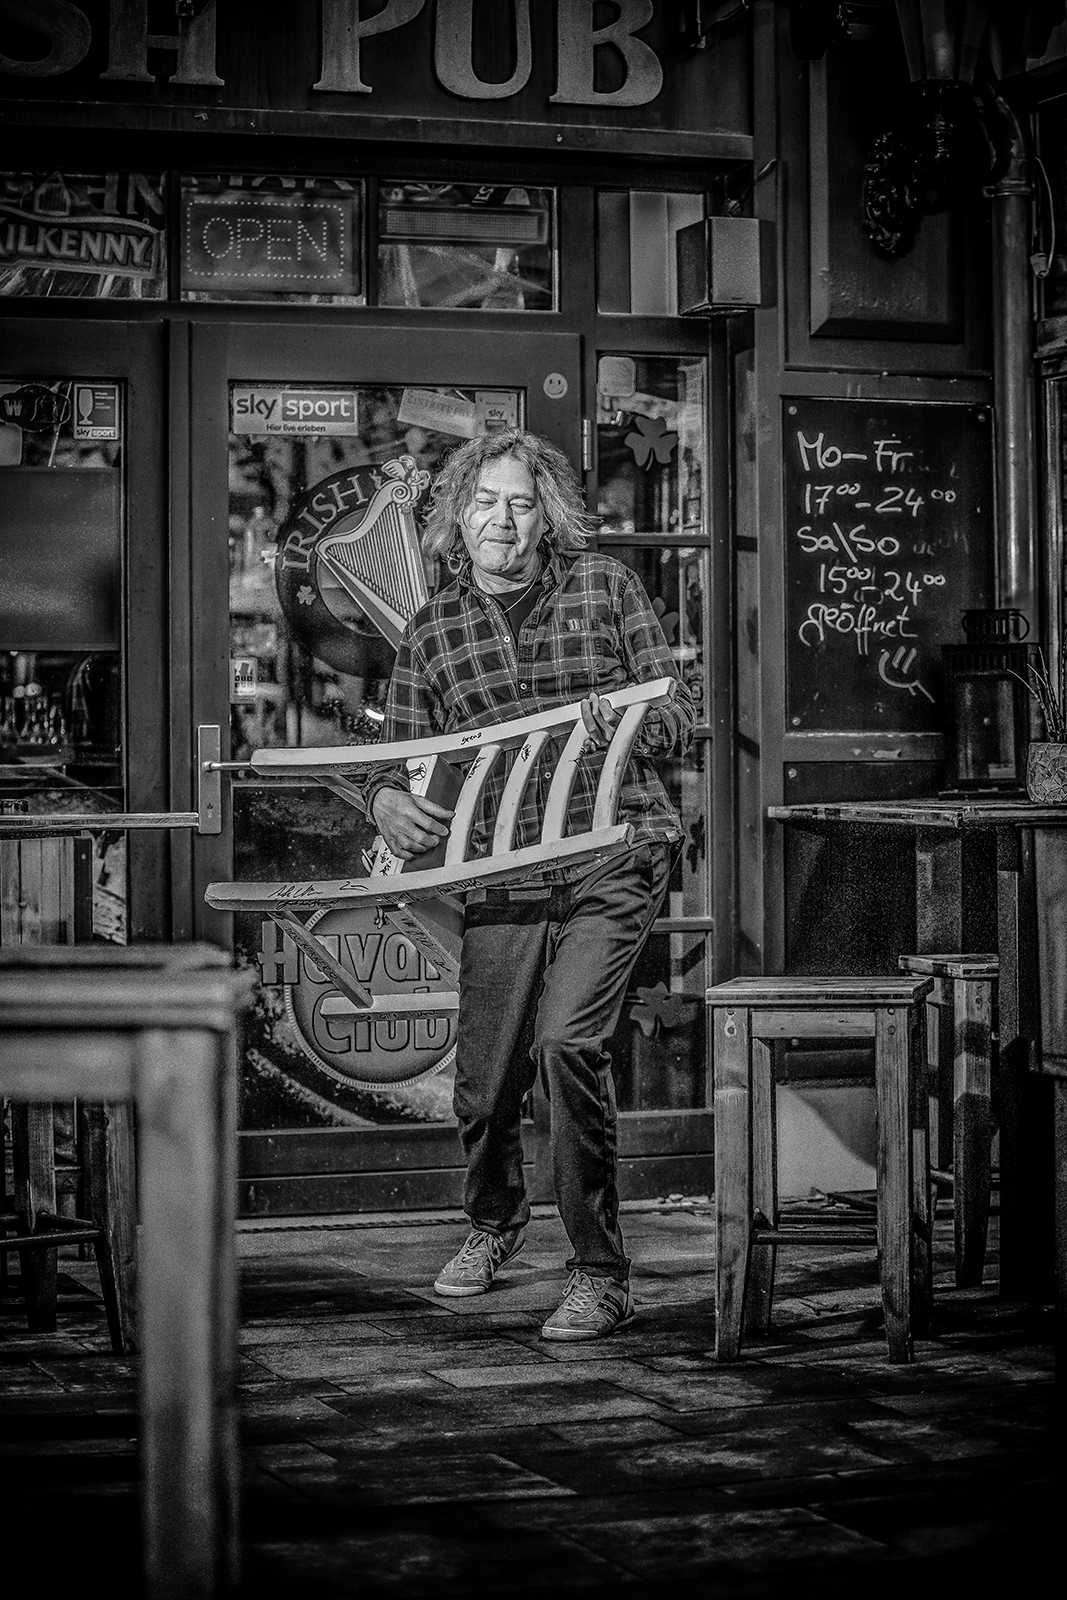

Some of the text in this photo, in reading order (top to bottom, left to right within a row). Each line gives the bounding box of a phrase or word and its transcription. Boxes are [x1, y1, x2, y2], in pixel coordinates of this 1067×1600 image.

[311, 0, 664, 108] PUB
[202, 217, 328, 262] OPEN
[236, 393, 351, 421] sky sport
[488, 408, 505, 419] sky
[76, 428, 115, 438] sky sport
[266, 424, 326, 432] Hier live erleben
[281, 474, 369, 573] IRISH
